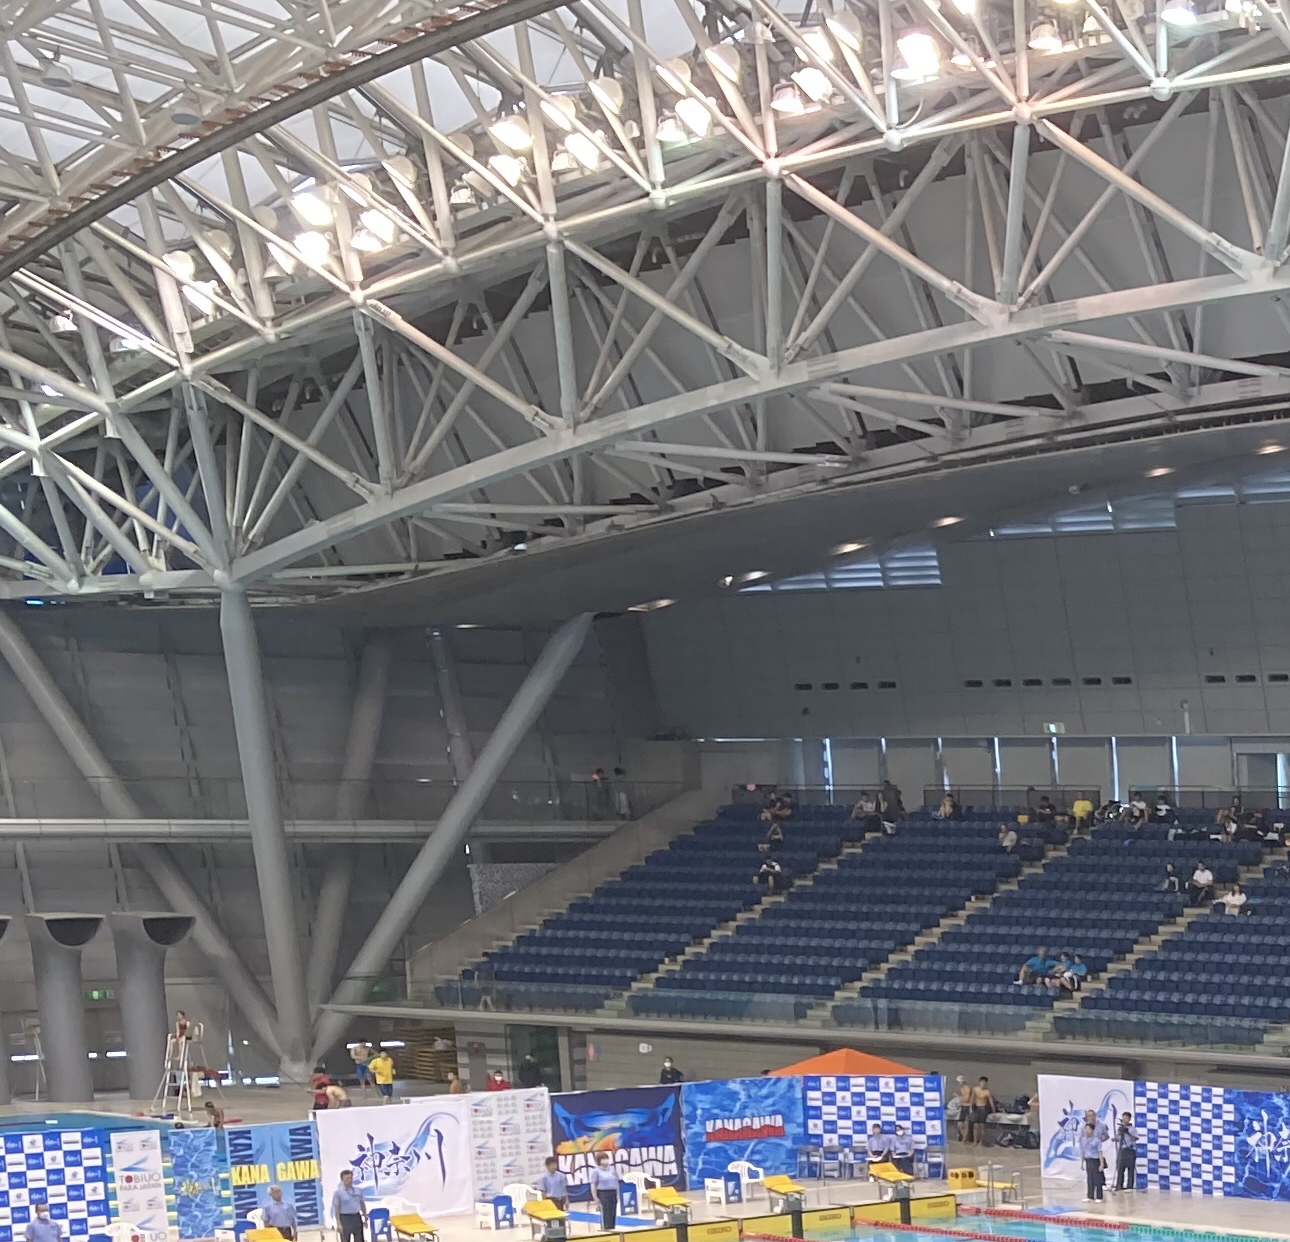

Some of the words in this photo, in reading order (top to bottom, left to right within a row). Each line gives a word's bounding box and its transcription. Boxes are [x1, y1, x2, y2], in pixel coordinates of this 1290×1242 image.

[231, 1163, 270, 1186] KANA
[276, 1159, 320, 1181] GAWA
[350, 1128, 446, 1193] 神奈川
